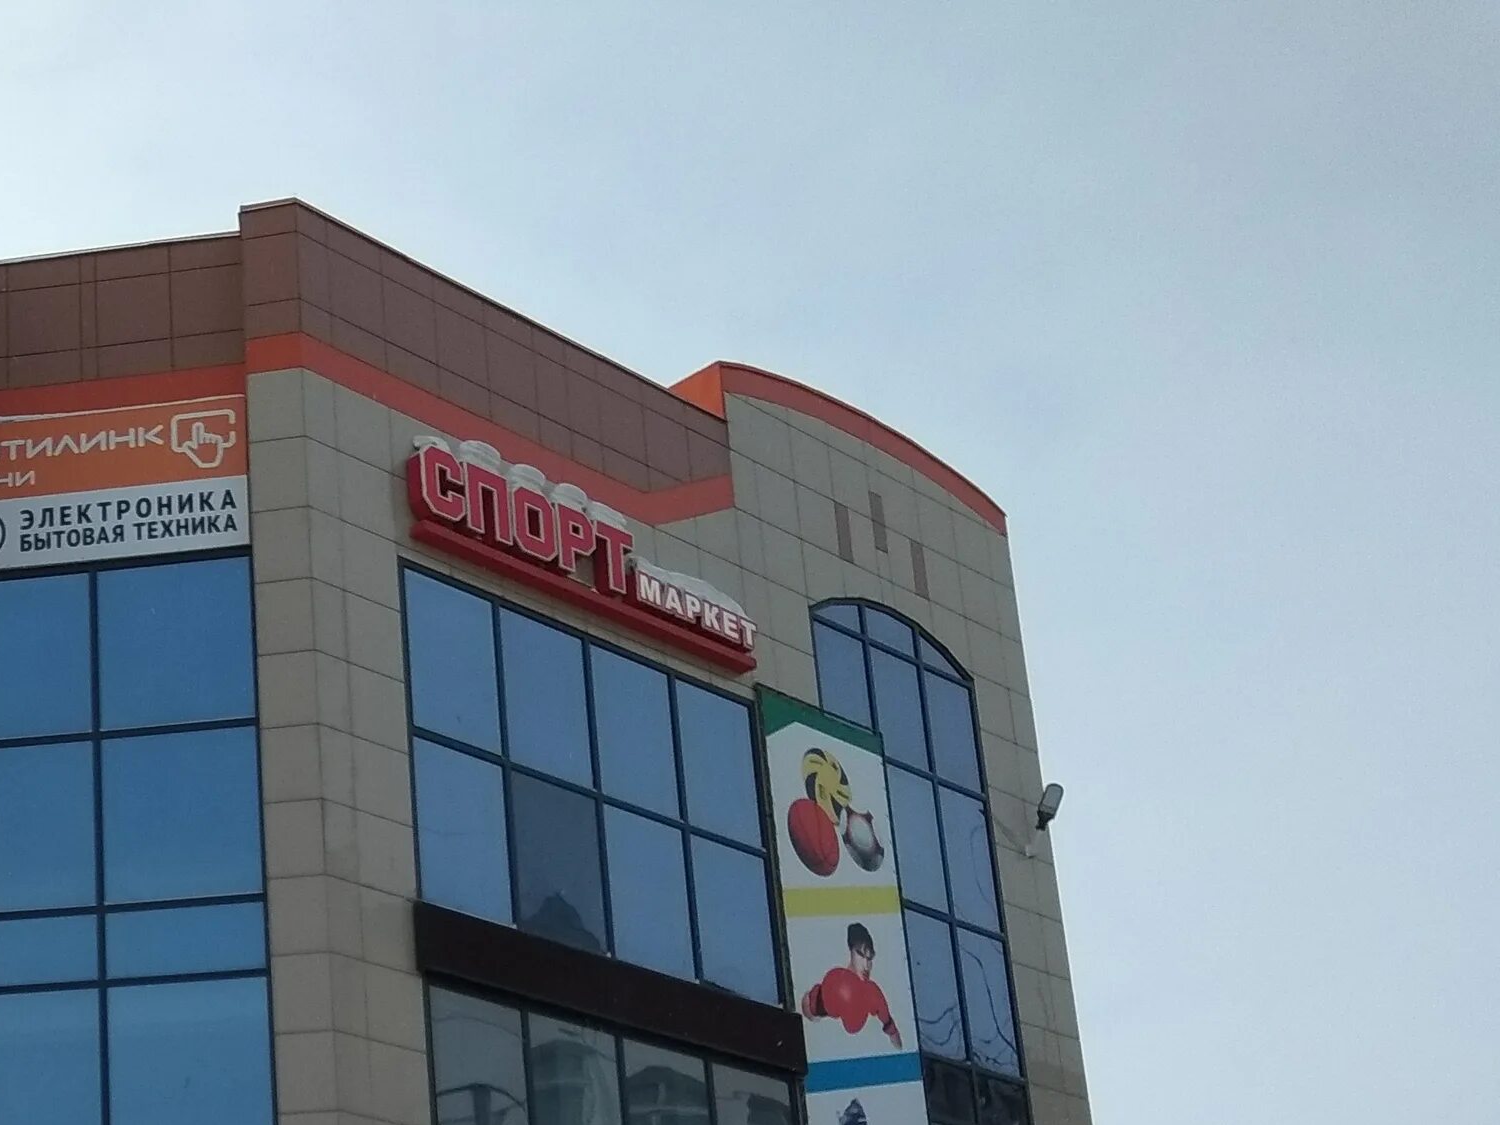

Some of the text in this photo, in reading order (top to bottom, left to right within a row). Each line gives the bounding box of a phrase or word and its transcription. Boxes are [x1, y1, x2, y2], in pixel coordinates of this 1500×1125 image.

[19, 489, 237, 530] ЭЛЕКТРОНИКА
[20, 514, 238, 552] БЫТОВАЯ ТЕХНИКА
[407, 445, 634, 594] СПОРТ
[635, 569, 757, 650] МАРКЕТ
